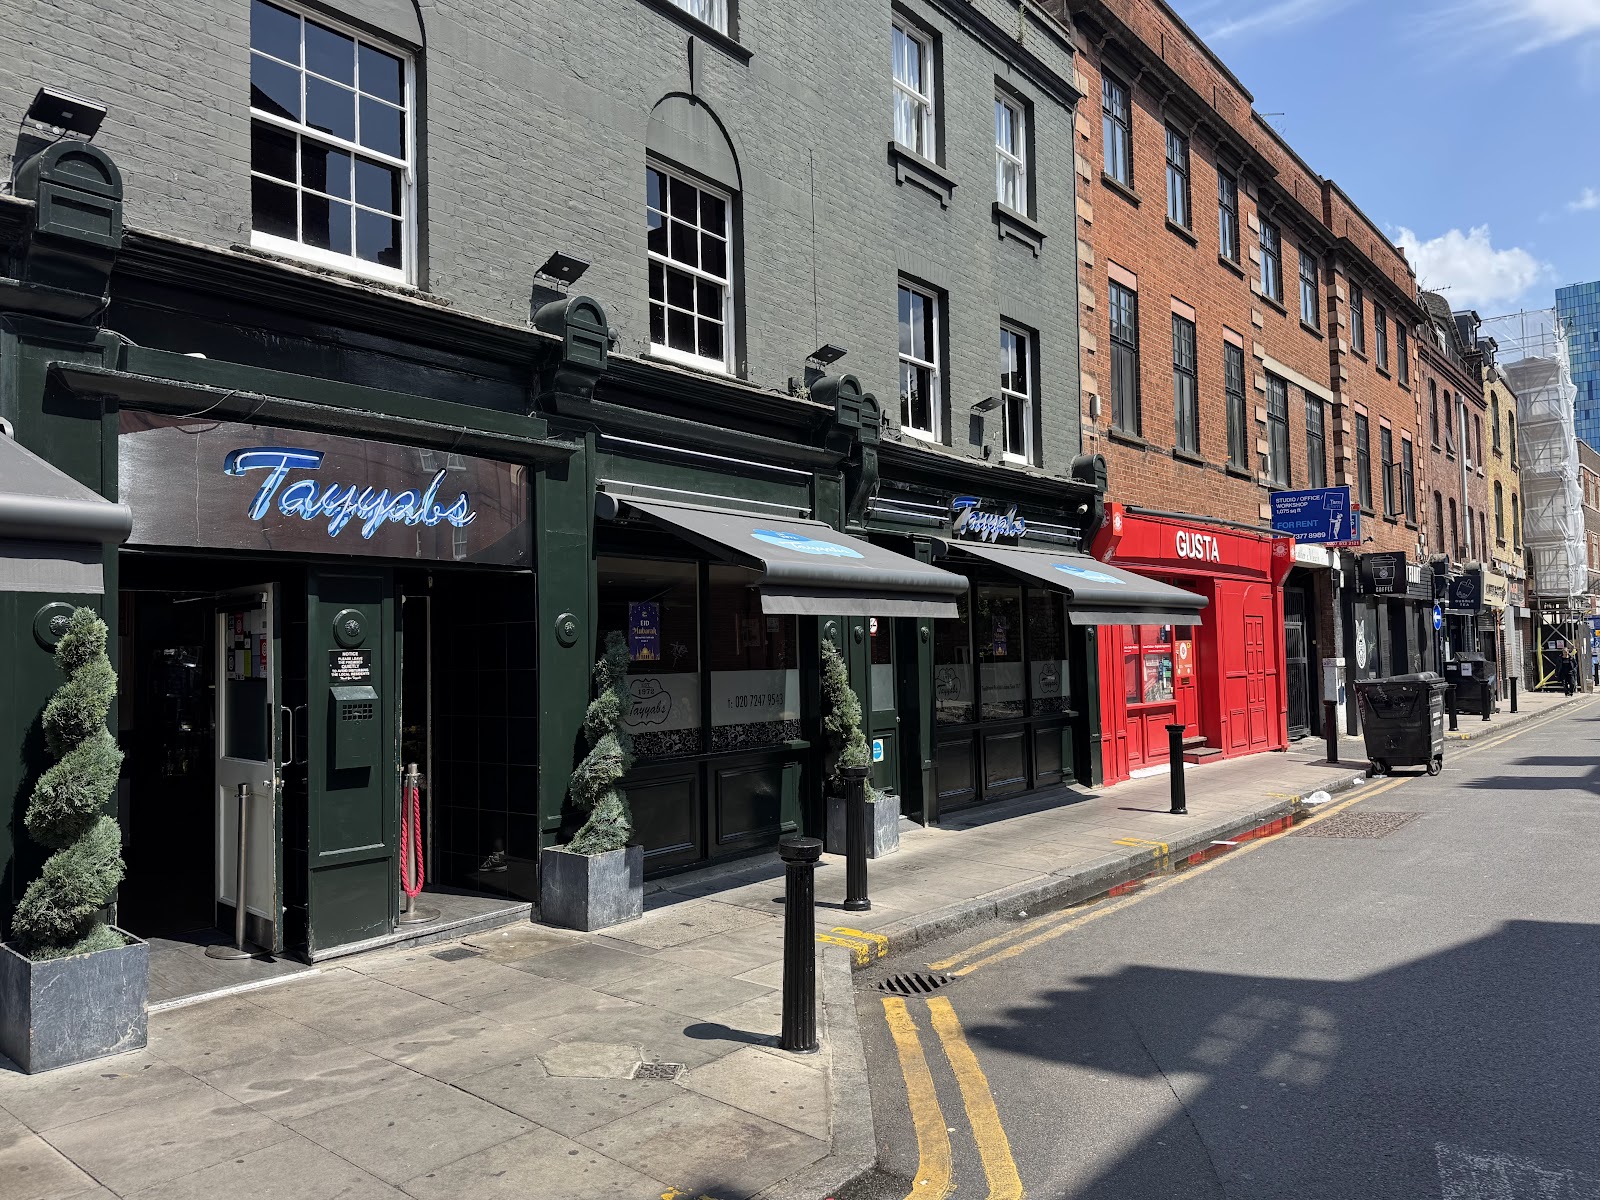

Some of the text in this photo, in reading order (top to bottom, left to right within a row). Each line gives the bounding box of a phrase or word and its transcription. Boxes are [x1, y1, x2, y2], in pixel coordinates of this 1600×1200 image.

[223, 446, 477, 539] Tayyabs
[1275, 501, 1308, 509] WORKSHOP
[952, 495, 1027, 543] Tayyabs
[1277, 520, 1319, 529] FOR RENT
[1176, 530, 1220, 562] GUSTA
[629, 700, 667, 718] Tayyabs
[735, 695, 748, 709] 020
[750, 694, 765, 707] 7247
